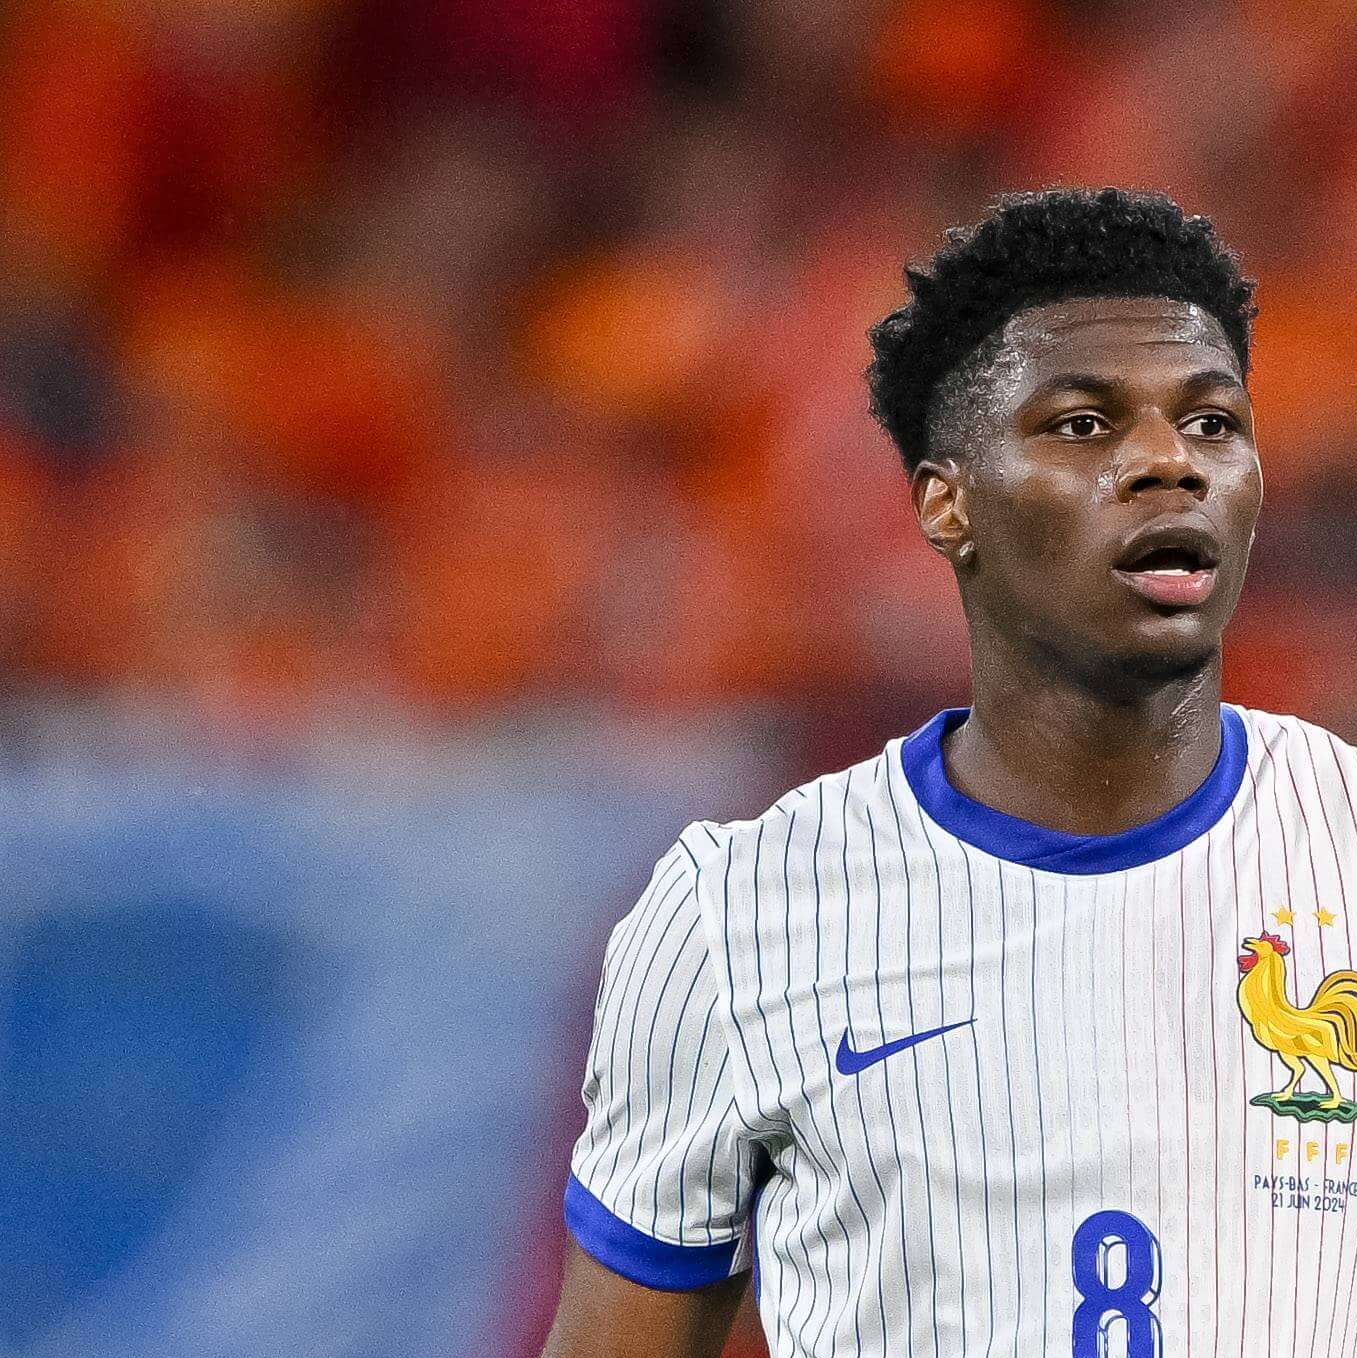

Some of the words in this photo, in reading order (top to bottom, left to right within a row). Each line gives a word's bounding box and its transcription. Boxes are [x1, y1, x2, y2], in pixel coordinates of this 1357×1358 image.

[1254, 1175, 1310, 1191] PAYS-BAS
[1272, 1192, 1283, 1208] 21
[1287, 1194, 1310, 1209] JUN
[1314, 1195, 1345, 1212] 2024
